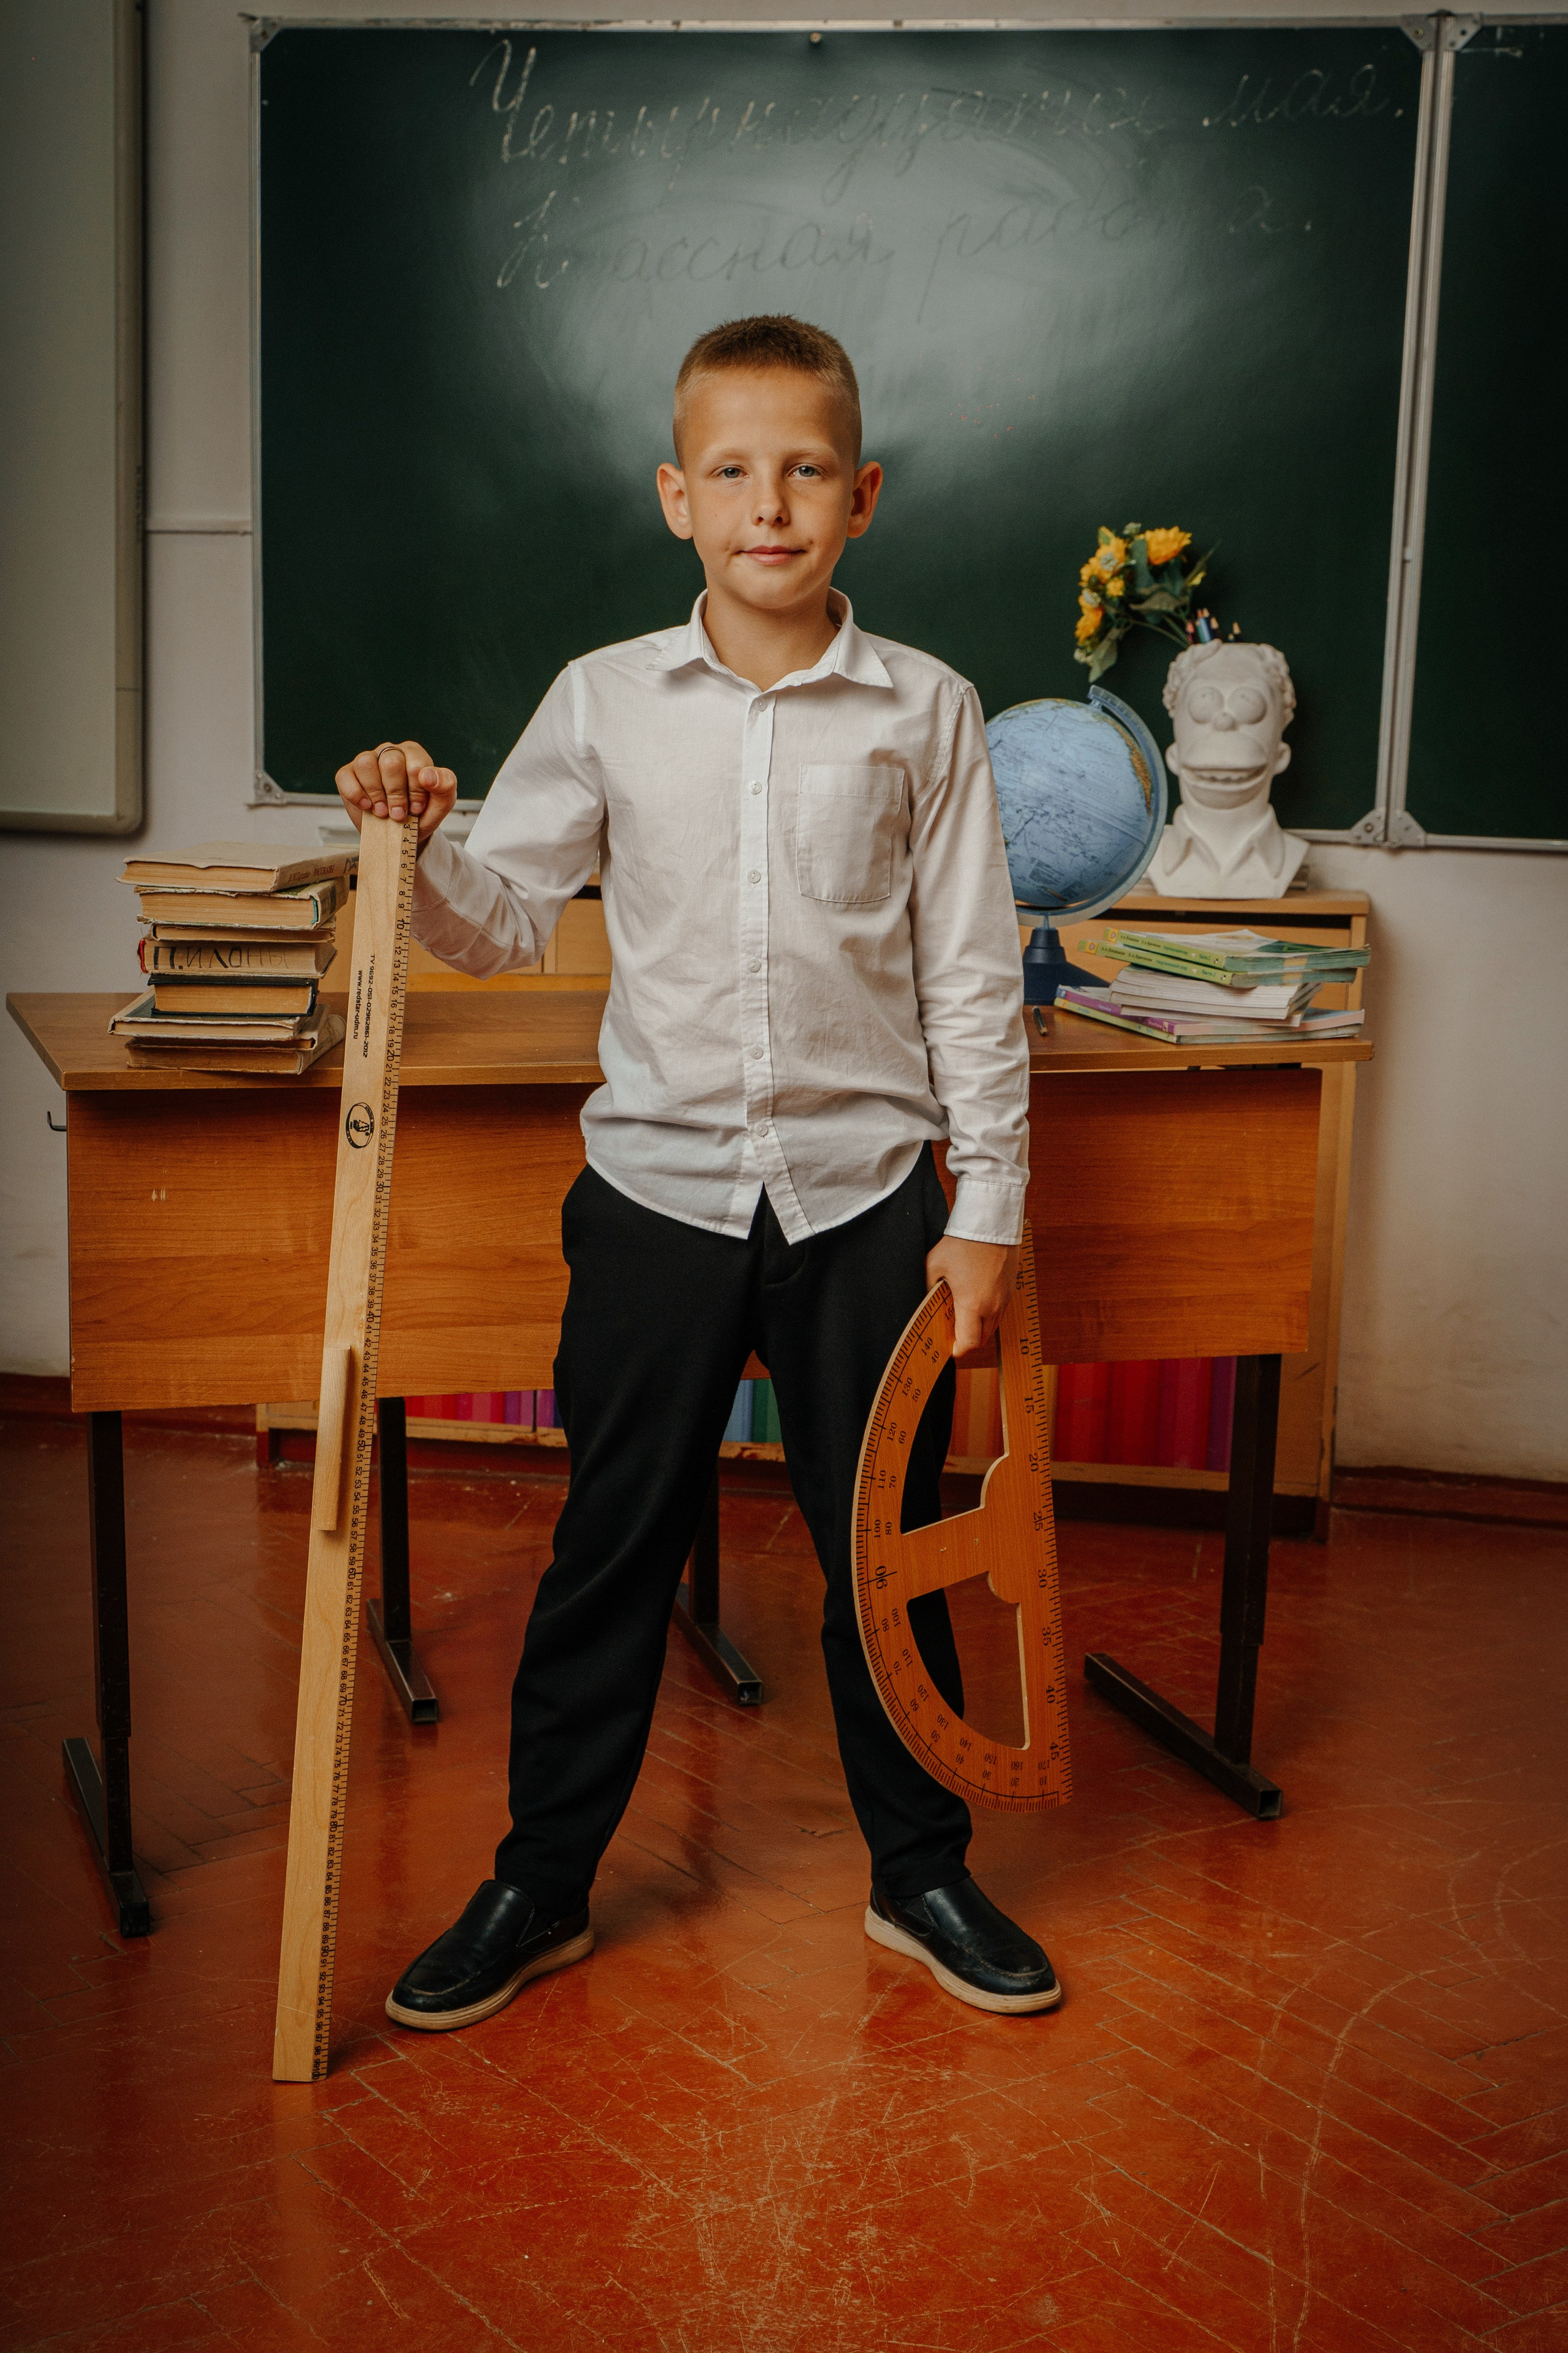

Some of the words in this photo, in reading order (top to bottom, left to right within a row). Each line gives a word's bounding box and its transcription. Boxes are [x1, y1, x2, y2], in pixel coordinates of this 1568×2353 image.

[496, 189, 895, 290] Кассная
[917, 175, 1313, 323] рабоа.
[396, 918, 404, 929] 10
[394, 945, 401, 955] 12
[393, 959, 400, 968] 13
[392, 972, 399, 981] 14
[391, 985, 398, 995] 15
[352, 970, 364, 1039] www.redstar-udm.ru
[390, 999, 397, 1008] 16
[363, 965, 374, 1057] 9692-051-02962861-2012
[389, 1012, 396, 1021] 17
[388, 1025, 395, 1034] 18
[386, 1038, 394, 1048] 19
[386, 1049, 394, 1061] 20
[385, 1063, 392, 1072] 21
[383, 1076, 391, 1087] 22
[383, 1089, 390, 1100] 23
[382, 1103, 389, 1112] 24
[381, 1116, 388, 1126] 25
[380, 1129, 387, 1139] 26
[379, 1143, 386, 1152] 27
[378, 1155, 385, 1165] 28
[377, 1168, 384, 1178] 29
[375, 1180, 384, 1193] 30
[375, 1195, 382, 1203] 31
[374, 1207, 381, 1217] 32
[373, 1221, 380, 1231] 33
[372, 1234, 379, 1243] 34
[371, 1247, 378, 1256] 35
[370, 1260, 377, 1269] 36
[369, 1273, 376, 1283] 37
[368, 1286, 375, 1295] 38
[1016, 1281, 1024, 1290] 5
[367, 1299, 374, 1309] 39
[366, 1310, 374, 1323] 40
[365, 1324, 372, 1333] 41
[364, 1337, 372, 1347] 42
[921, 1337, 933, 1356] 140
[1020, 1339, 1030, 1355] 10
[363, 1350, 371, 1361] 43
[931, 1350, 940, 1364] 40
[362, 1363, 370, 1373] 44
[361, 1376, 369, 1386] 45
[902, 1377, 913, 1397] 130
[360, 1389, 368, 1399] 46
[912, 1388, 921, 1402] 50
[360, 1402, 367, 1412] 47
[1024, 1396, 1035, 1414] 15
[358, 1414, 366, 1425] 48
[358, 1428, 365, 1438] 49
[887, 1422, 897, 1442] 120
[899, 1430, 907, 1445] 60
[356, 1440, 365, 1451] 50
[356, 1453, 363, 1462] 51
[1029, 1452, 1039, 1472] 20
[355, 1466, 362, 1476] 52
[354, 1479, 361, 1489] 53
[878, 1470, 886, 1489] 110
[889, 1475, 897, 1489] 70
[353, 1492, 360, 1501] 54
[352, 1505, 360, 1514] 55
[351, 1517, 358, 1527] 56
[1033, 1511, 1043, 1532] 25
[885, 1522, 892, 1535] 80
[350, 1530, 358, 1540] 57
[349, 1543, 356, 1553] 58
[349, 1556, 356, 1566] 59
[347, 1567, 356, 1579] 60
[875, 1565, 888, 1590] 90
[1038, 1569, 1047, 1588] 30
[347, 1581, 354, 1590] 61
[345, 1594, 353, 1604] 62
[345, 1607, 352, 1617] 63
[891, 1608, 901, 1628] 100
[344, 1620, 351, 1630] 64
[881, 1618, 889, 1632] 80
[342, 1632, 350, 1642] 65
[1042, 1626, 1052, 1646] 35
[342, 1645, 349, 1655] 66
[341, 1658, 349, 1667] 67
[902, 1649, 913, 1667] 110
[893, 1661, 902, 1675] 70
[340, 1670, 347, 1680] 68
[339, 1683, 347, 1693] 69
[918, 1684, 929, 1702] 120
[1046, 1685, 1056, 1704] 40
[338, 1694, 347, 1706] 70
[910, 1699, 919, 1712] 60
[337, 1707, 345, 1717] 71
[336, 1721, 344, 1731] 72
[937, 1714, 949, 1730] 130
[336, 1733, 343, 1743] 73
[932, 1729, 940, 1743] 50
[959, 1737, 972, 1751] 140
[334, 1745, 342, 1755] 74
[1050, 1742, 1059, 1761] 45
[334, 1758, 341, 1768] 75
[956, 1754, 965, 1764] 40
[984, 1753, 997, 1765] 150
[1011, 1761, 1023, 1770] 160
[333, 1771, 340, 1781] 76
[982, 1770, 992, 1780] 30
[1011, 1777, 1019, 1787] 20
[1039, 1776, 1047, 1786] 10
[332, 1784, 339, 1793] 77
[331, 1796, 338, 1806] 78
[330, 1809, 337, 1819] 79
[329, 1821, 337, 1832] 80
[328, 1834, 336, 1843] 81
[327, 1846, 334, 1856] 82
[326, 1859, 334, 1869] 83
[325, 1871, 333, 1881] 84
[325, 1884, 332, 1894] 85
[324, 1897, 331, 1906] 86
[323, 1909, 330, 1919] 87
[322, 1922, 330, 1932] 88
[321, 1934, 328, 1944] 89
[320, 1945, 329, 1957] 90
[320, 1958, 327, 1967] 91
[318, 1971, 326, 1981] 92
[318, 1983, 325, 1993] 93
[317, 1996, 324, 2006] 94
[316, 2008, 323, 2019] 95
[315, 2021, 322, 2031] 96
[314, 2033, 322, 2042] 97
[313, 2045, 320, 2056] 98
[312, 2058, 320, 2068] 99
[311, 2068, 320, 2080] 100
